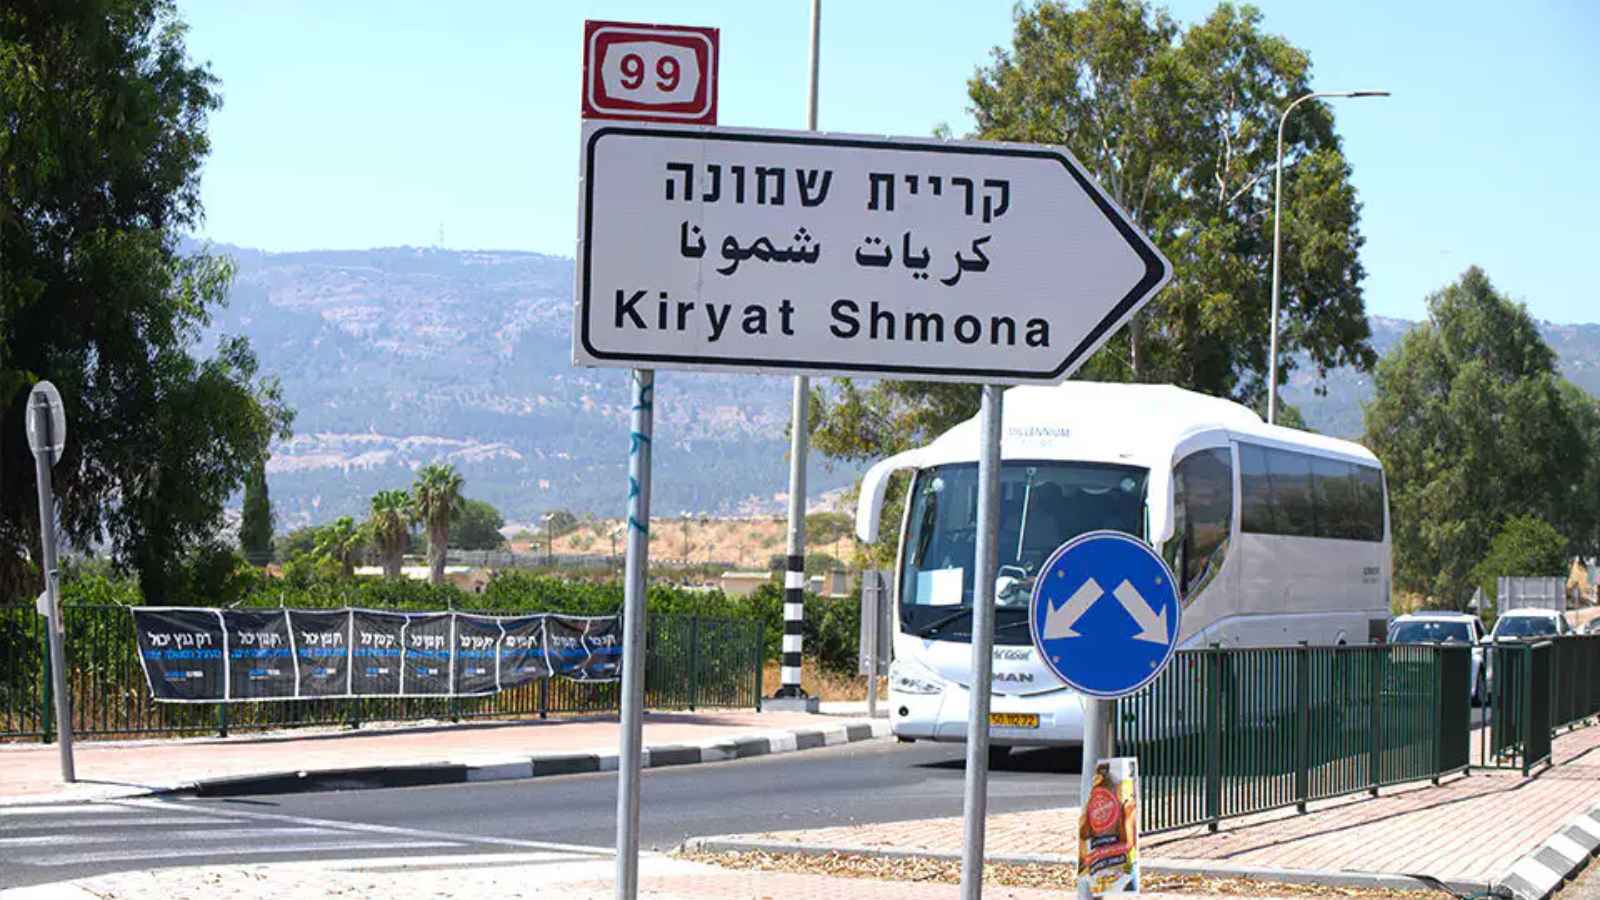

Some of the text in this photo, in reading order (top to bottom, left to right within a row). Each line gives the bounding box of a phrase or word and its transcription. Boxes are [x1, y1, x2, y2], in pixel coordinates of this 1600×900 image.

[620, 54, 681, 92] 99
[666, 162, 1010, 223] קריית שמונה
[681, 221, 991, 286] كريات شمونا
[615, 290, 1049, 347] Kiryat Shmona
[147, 631, 213, 650] רק גנץ יכול
